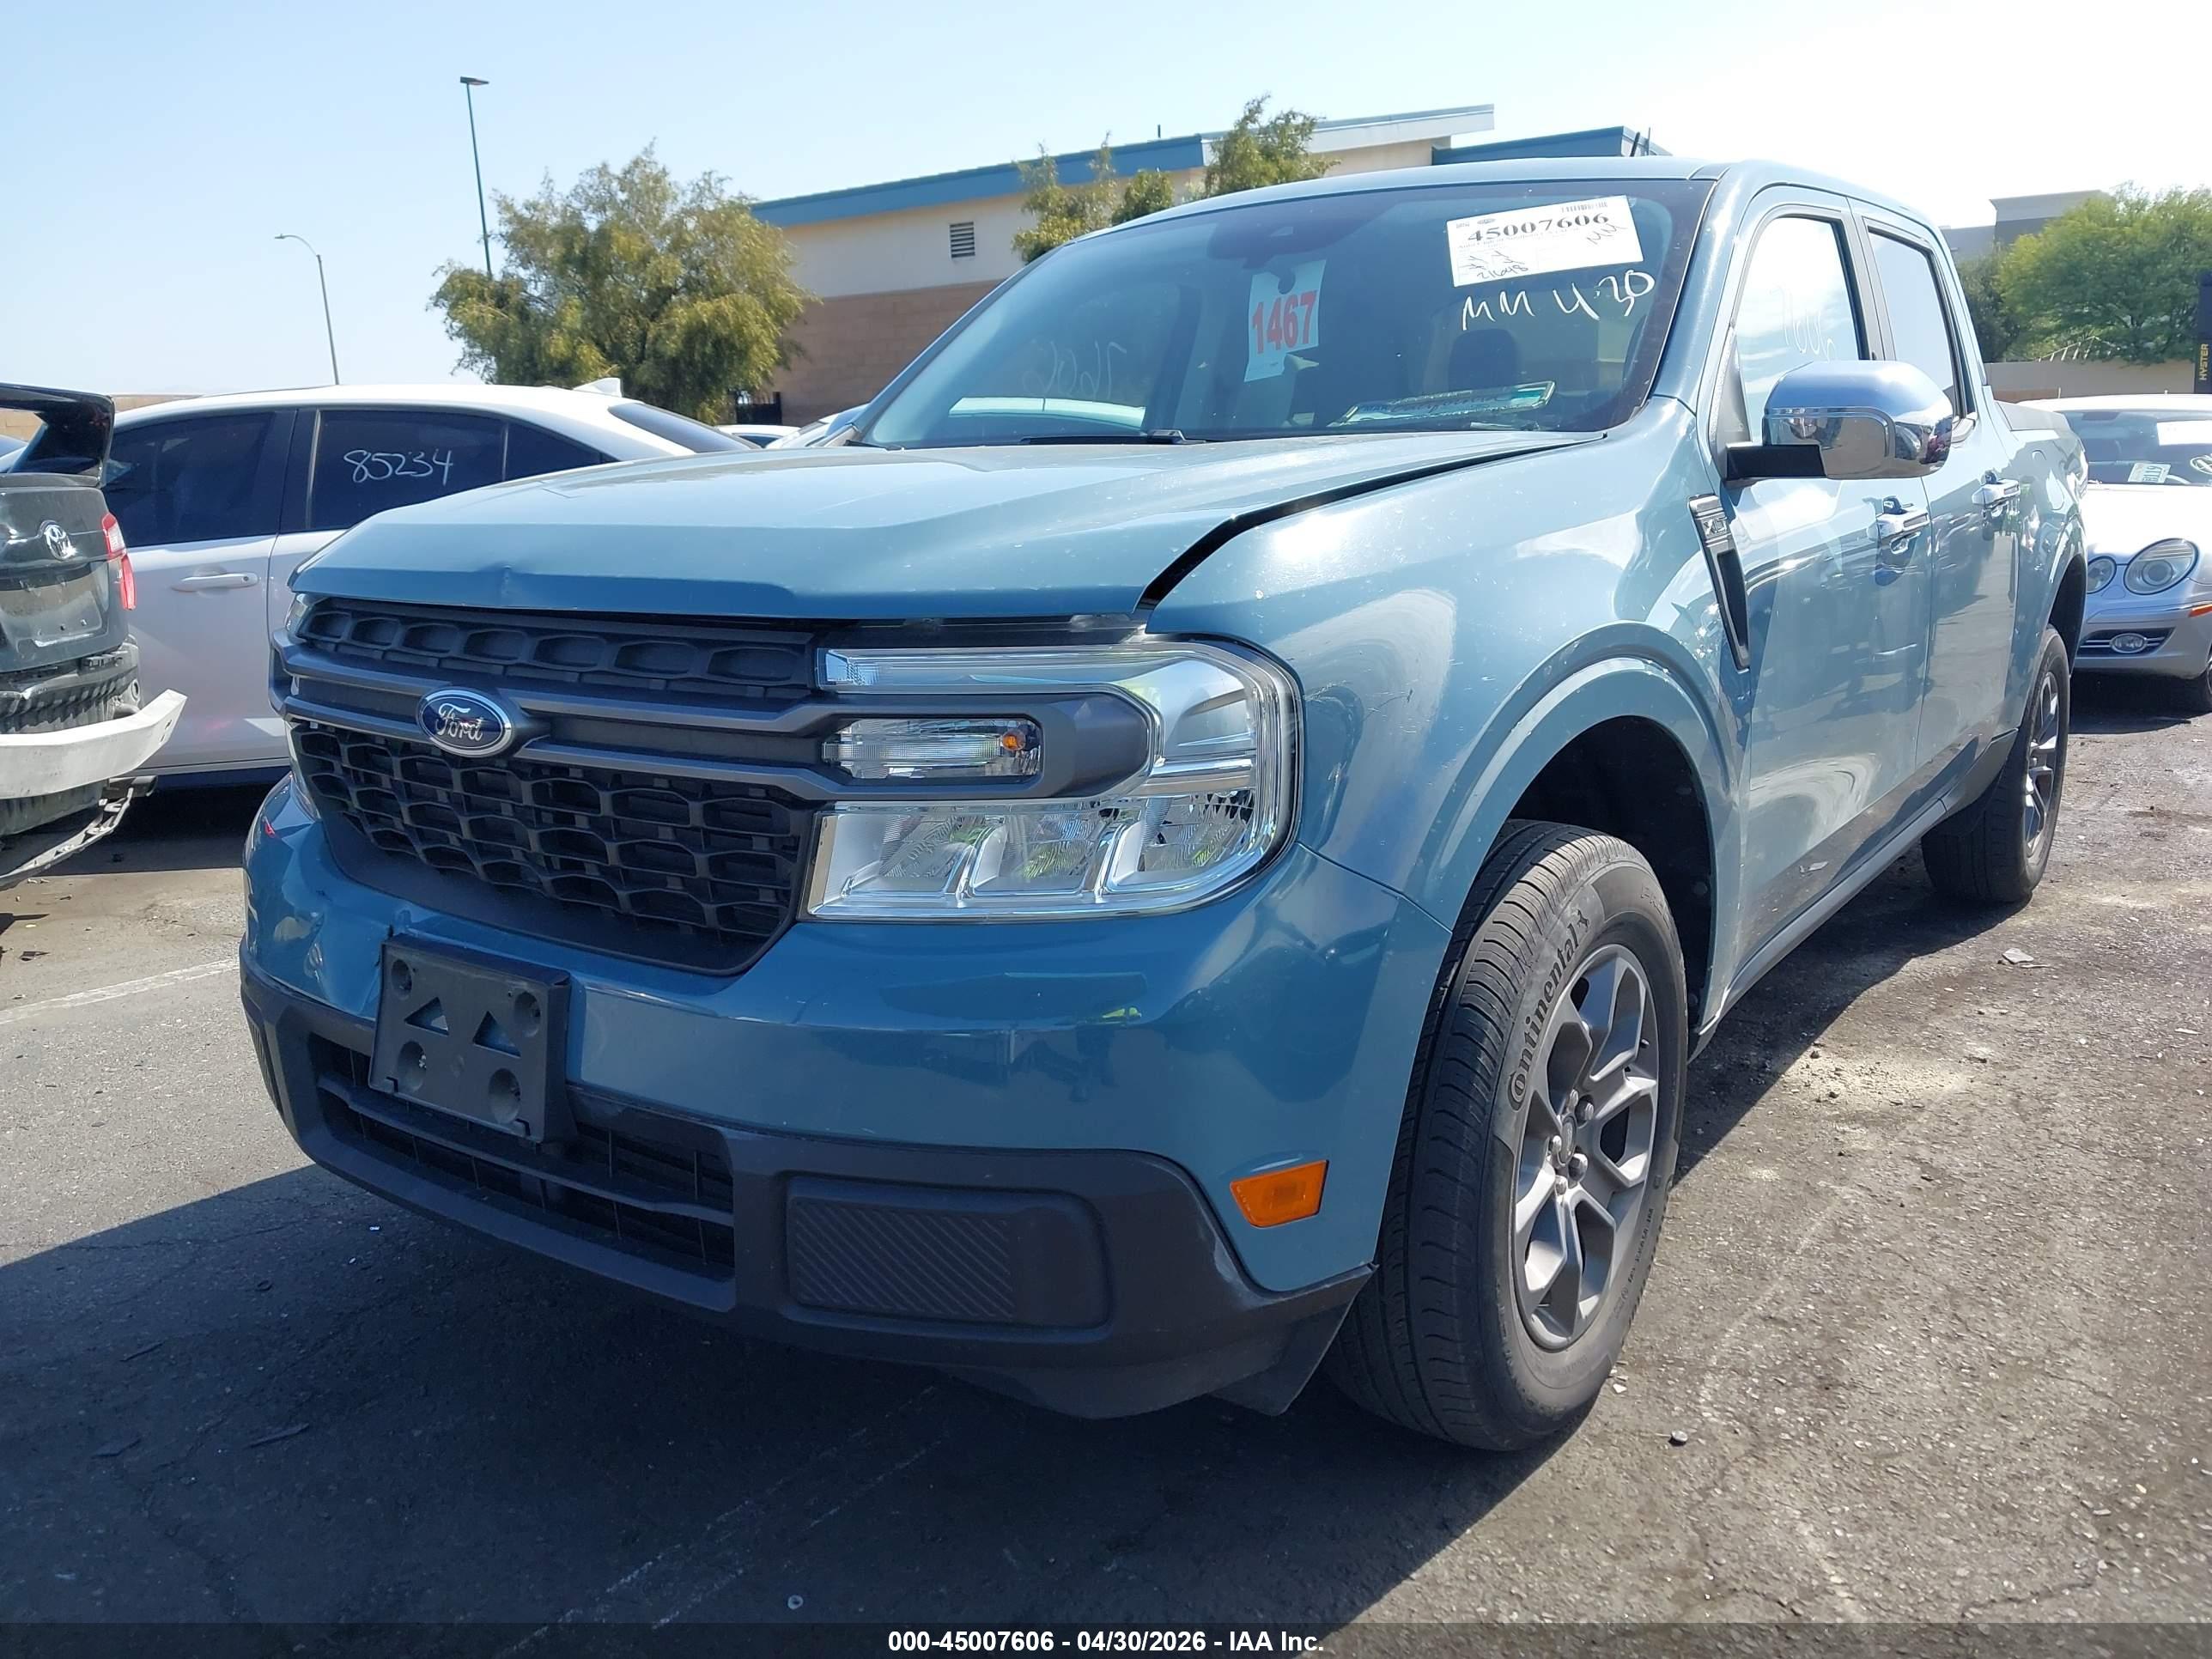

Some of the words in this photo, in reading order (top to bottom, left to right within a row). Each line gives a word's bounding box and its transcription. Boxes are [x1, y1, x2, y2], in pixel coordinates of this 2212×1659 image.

[1468, 212, 1610, 242] 45007606
[1252, 290, 1317, 355] 1467
[2198, 343, 2209, 381] HYSTER
[343, 448, 454, 487] 85234
[435, 702, 483, 742] Ford
[1507, 922, 1579, 1112] Continental
